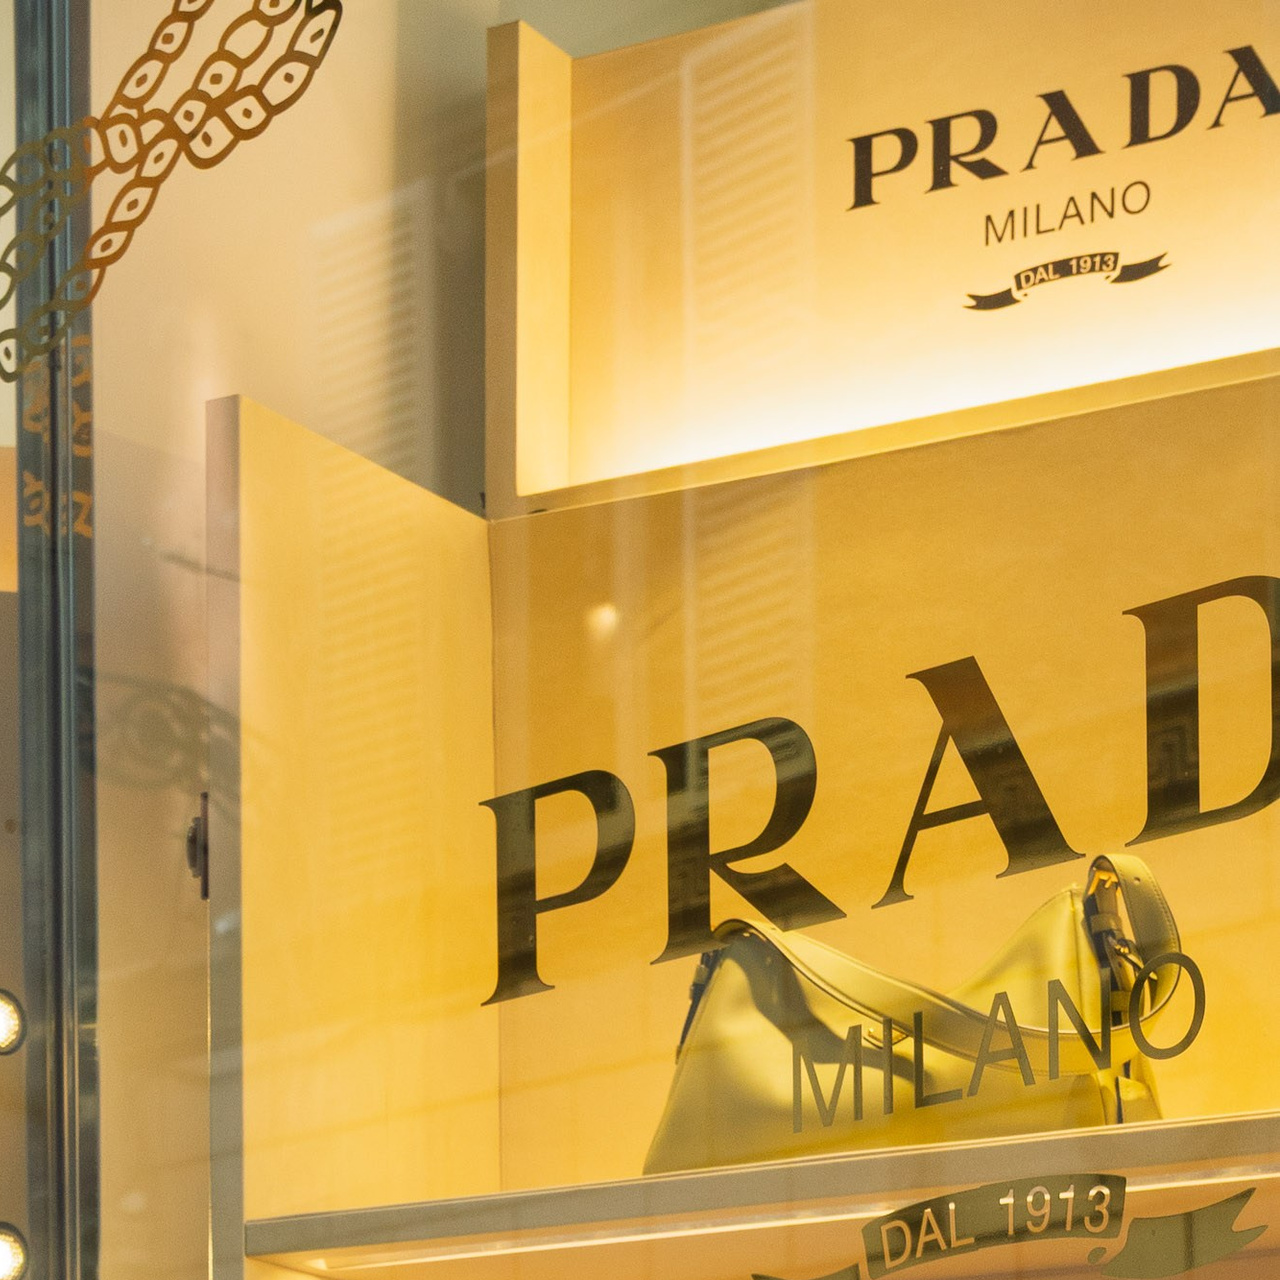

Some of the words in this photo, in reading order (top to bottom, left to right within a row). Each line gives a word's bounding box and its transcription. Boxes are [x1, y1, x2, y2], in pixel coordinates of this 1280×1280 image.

[846, 45, 1280, 212] PRADA
[984, 181, 1151, 247] MILANO
[1019, 263, 1060, 290] DAL
[1069, 254, 1115, 275] 1913
[791, 951, 1206, 1134] MILANO
[880, 1202, 975, 1270] DAL
[999, 1184, 1111, 1236] 1913
